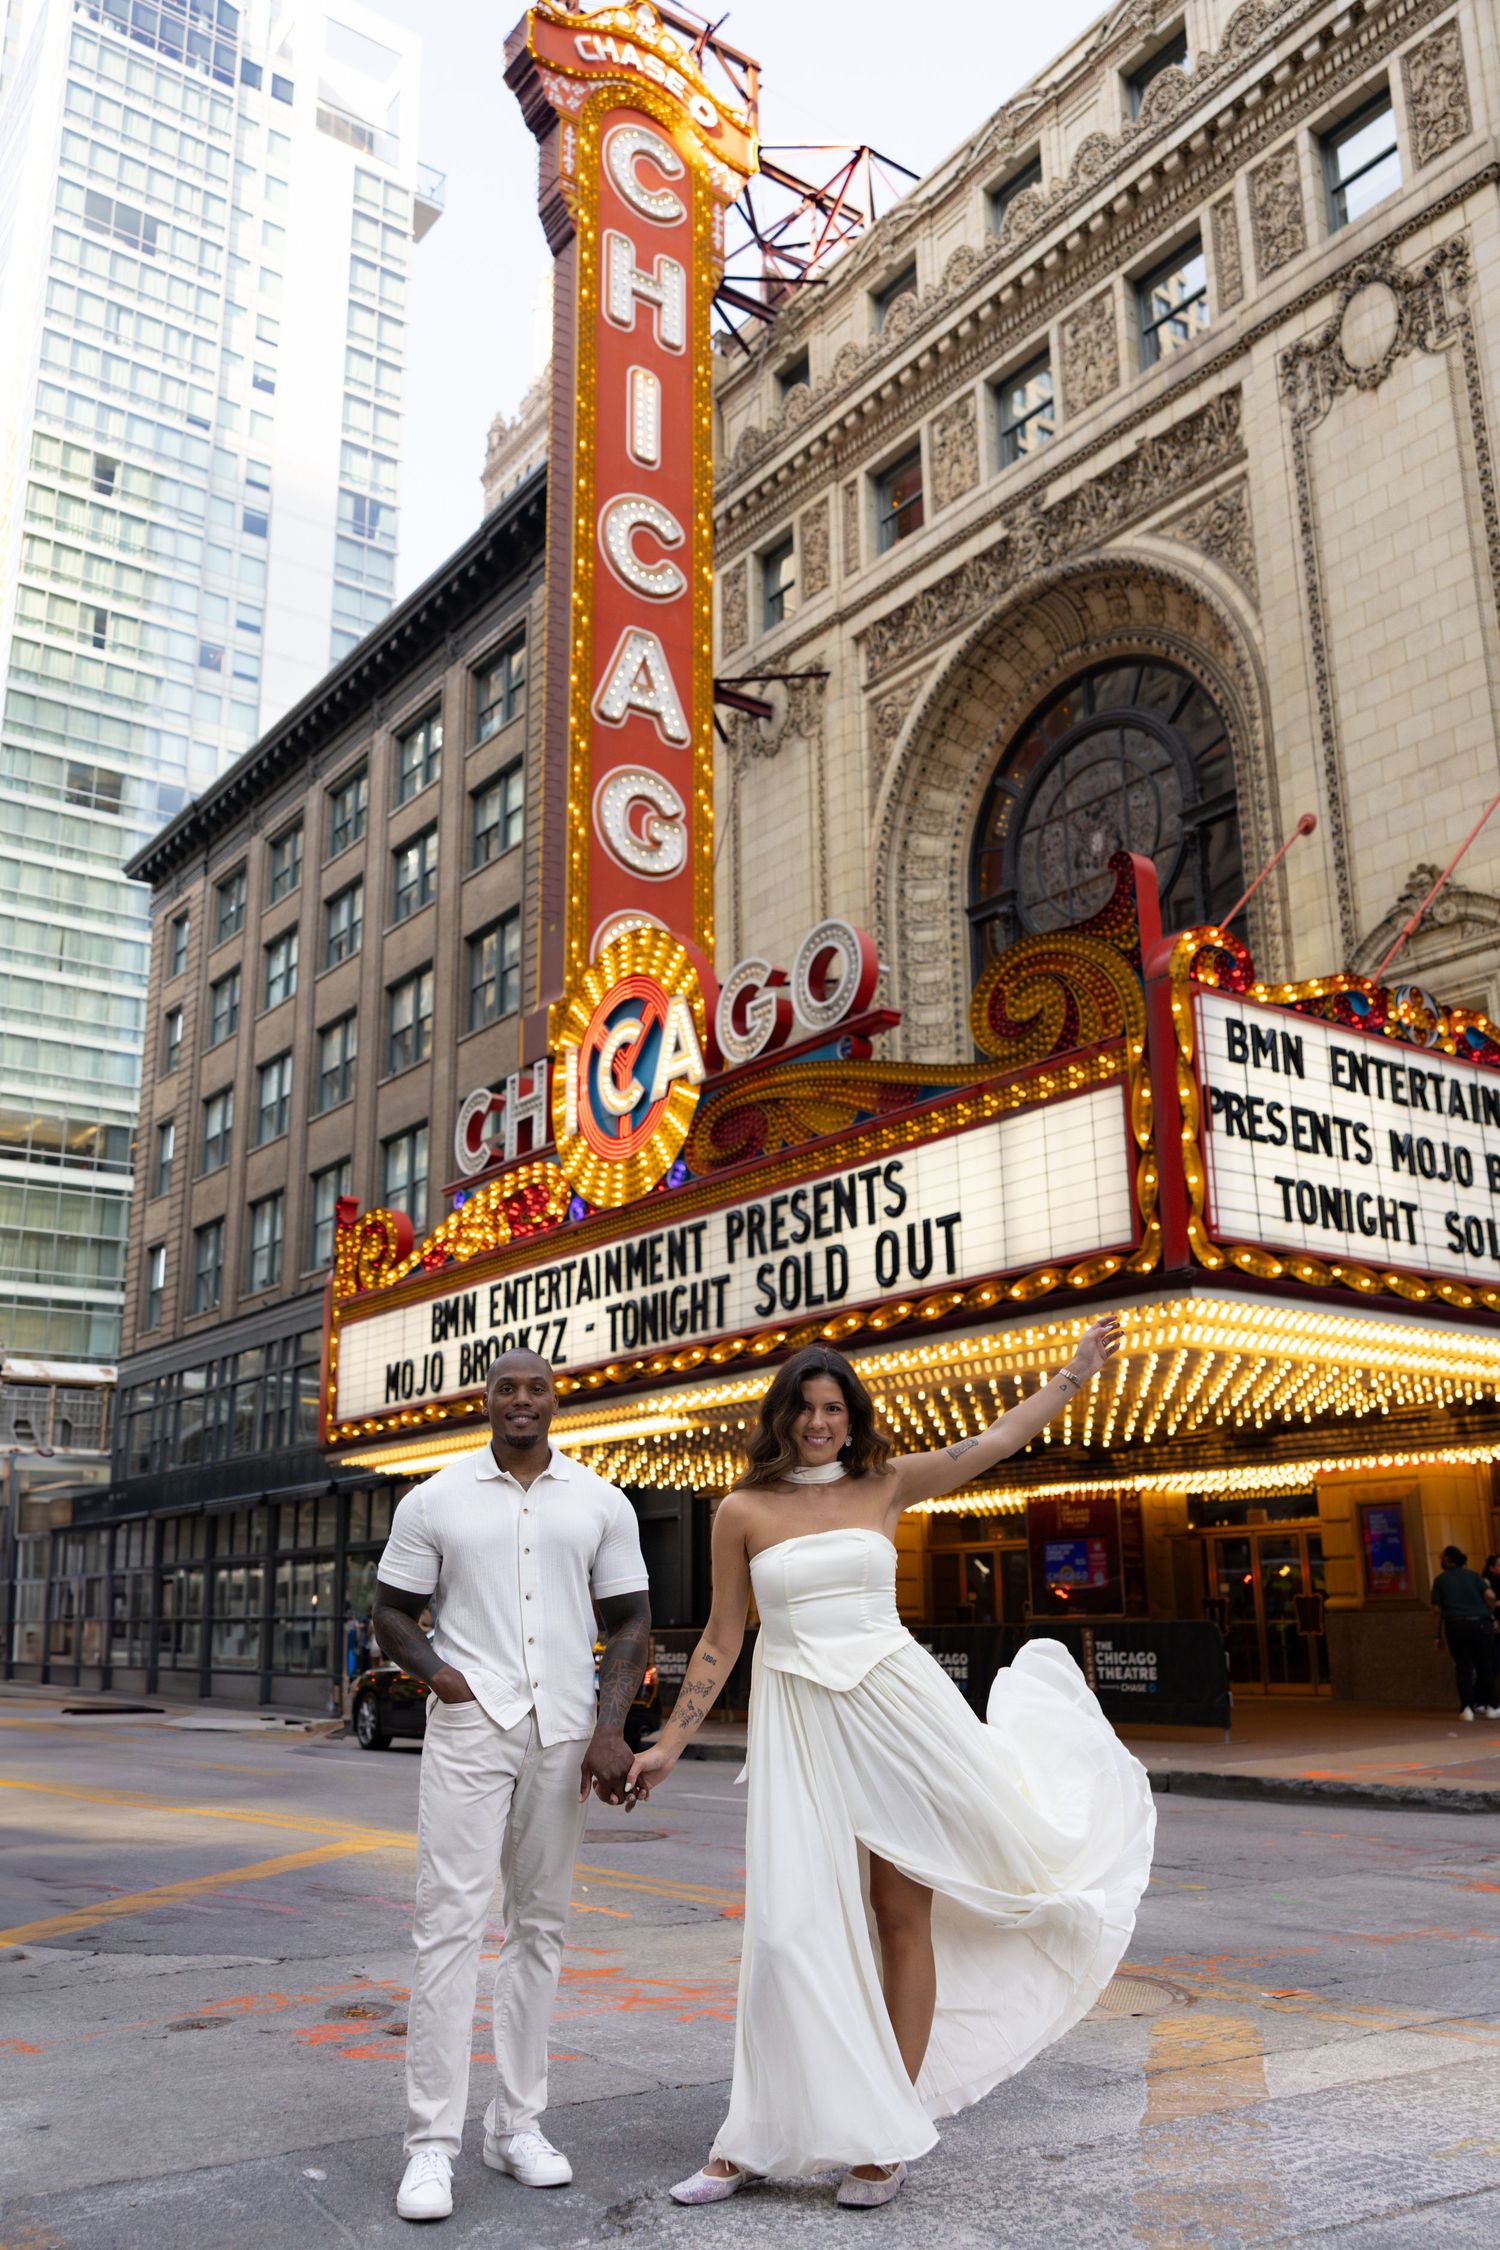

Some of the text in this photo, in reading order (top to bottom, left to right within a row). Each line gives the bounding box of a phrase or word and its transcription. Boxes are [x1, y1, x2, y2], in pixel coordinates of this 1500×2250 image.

[574, 34, 688, 98] CHASE
[455, 918, 872, 1177] CHICAGO
[1225, 1017, 1305, 1079] BMN
[1202, 1083, 1373, 1165] PRESENTS
[1389, 1128, 1474, 1188] MOJO
[1274, 1175, 1418, 1245] TONIGHT
[431, 1160, 907, 1344] BMN ENTERTAINMENT PRESENTS
[385, 1351, 444, 1404] MOJO
[606, 1274, 730, 1352] TONIGHT
[754, 1244, 849, 1318] SOLD
[875, 1212, 962, 1288] OUT
[932, 1652, 969, 1666] CAGO
[1095, 1641, 1113, 1651] THE
[1095, 1651, 1158, 1666] CHICAGO
[1096, 1666, 1158, 1681] THEATRE
